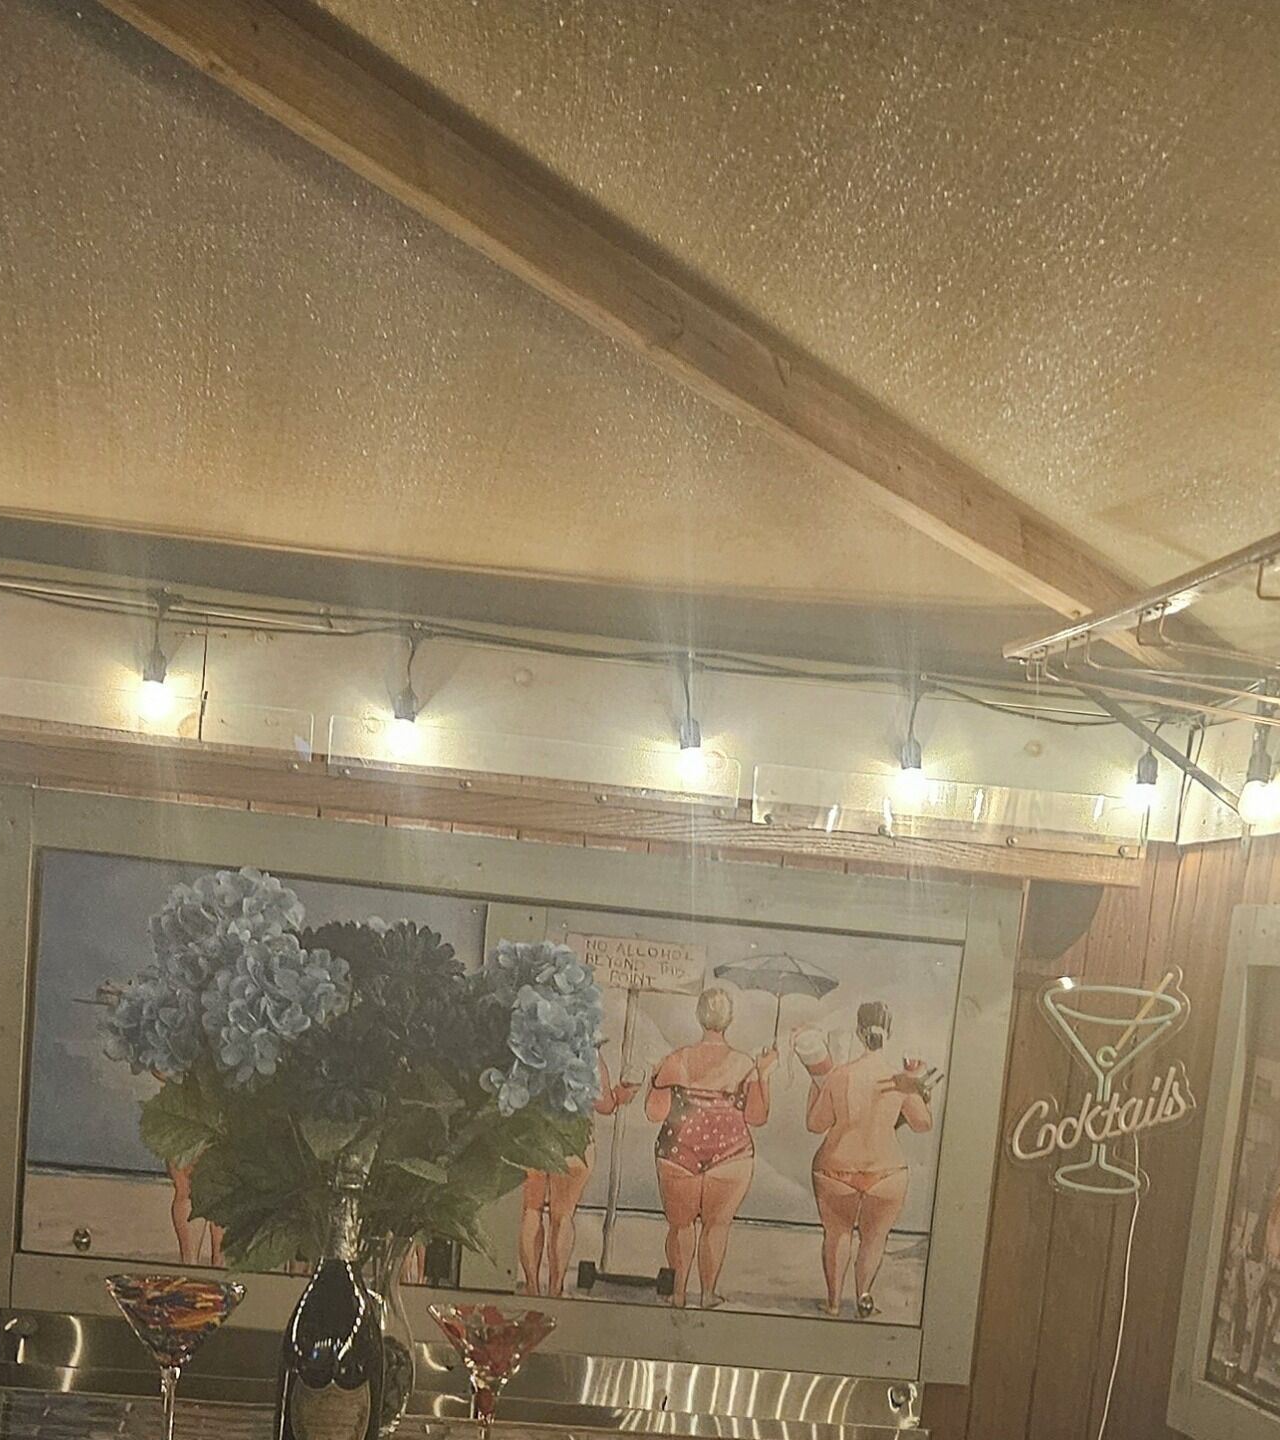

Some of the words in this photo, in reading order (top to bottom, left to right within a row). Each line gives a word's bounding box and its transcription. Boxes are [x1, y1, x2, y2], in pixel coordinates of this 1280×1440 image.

[585, 940, 608, 953] NO
[585, 952, 647, 971] BEYOND
[609, 968, 657, 987] POINT
[1012, 1066, 1187, 1160] Cocktails
